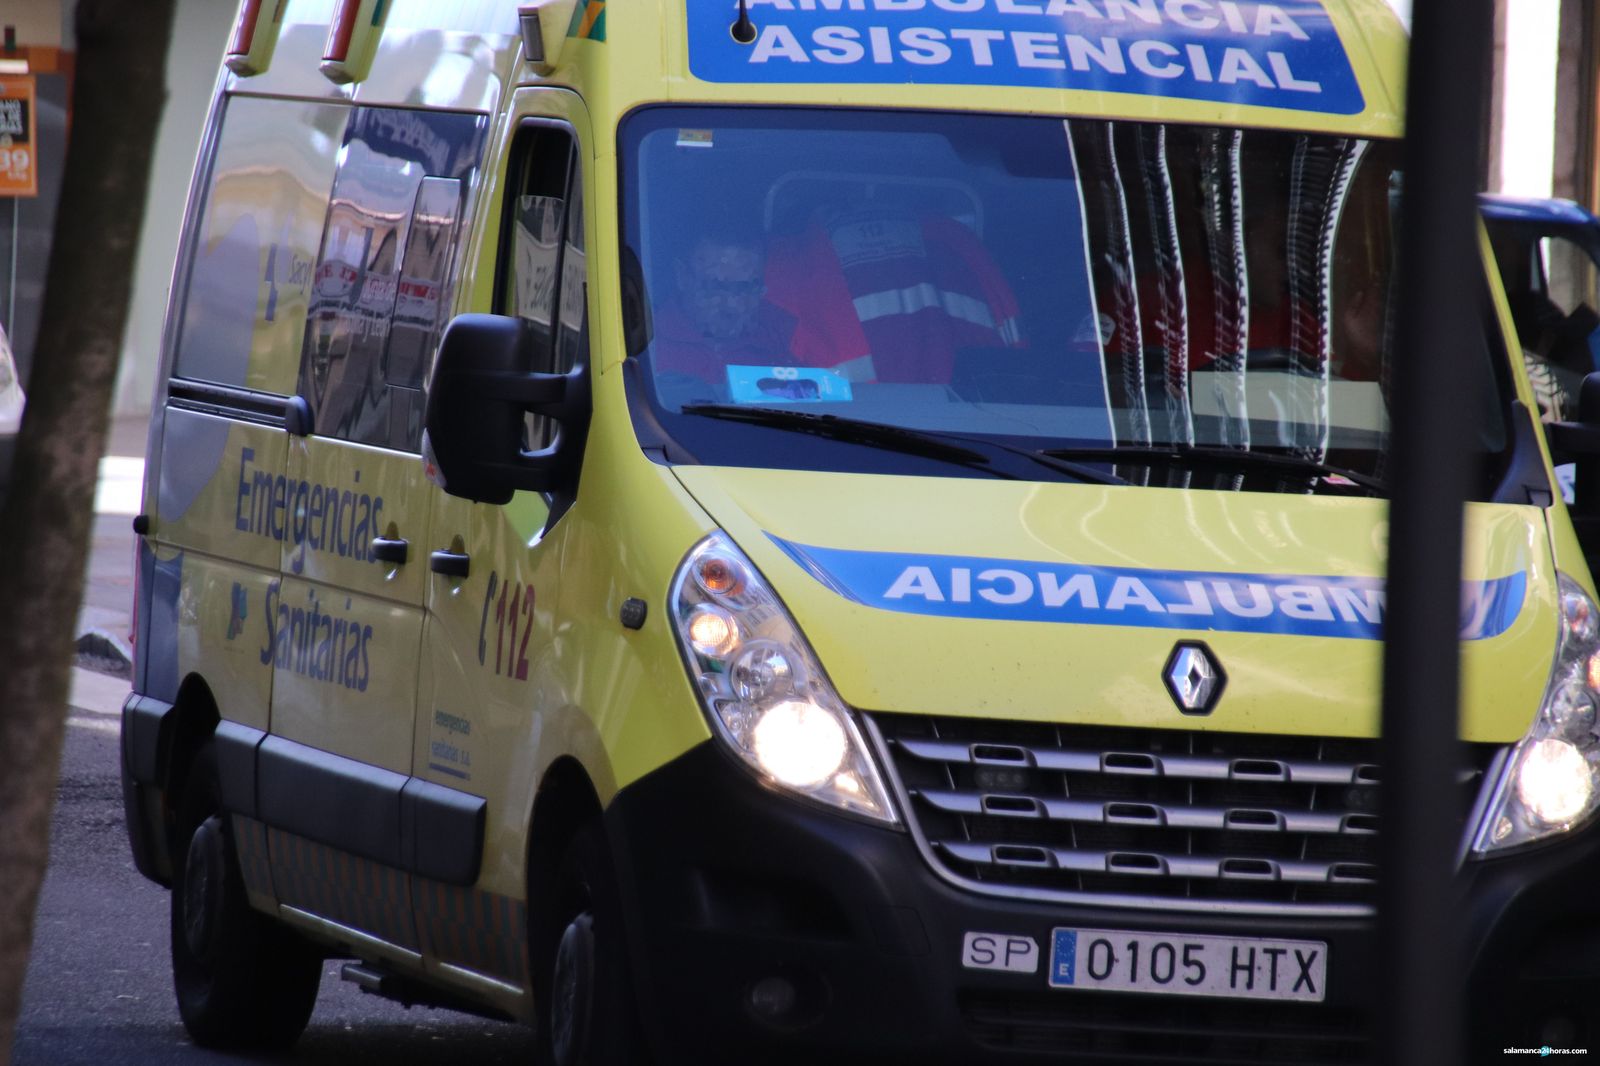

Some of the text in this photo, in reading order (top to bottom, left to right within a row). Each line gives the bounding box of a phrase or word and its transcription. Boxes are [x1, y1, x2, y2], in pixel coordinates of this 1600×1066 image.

[734, 0, 1310, 40] ANCIA
[748, 25, 1323, 92] ASISTENCIAL
[235, 447, 384, 573] Emergencias
[260, 578, 374, 692] Sanitarias
[496, 579, 535, 681] 112
[970, 936, 1032, 967] SP
[1058, 938, 1319, 994] E 0105 HTX
